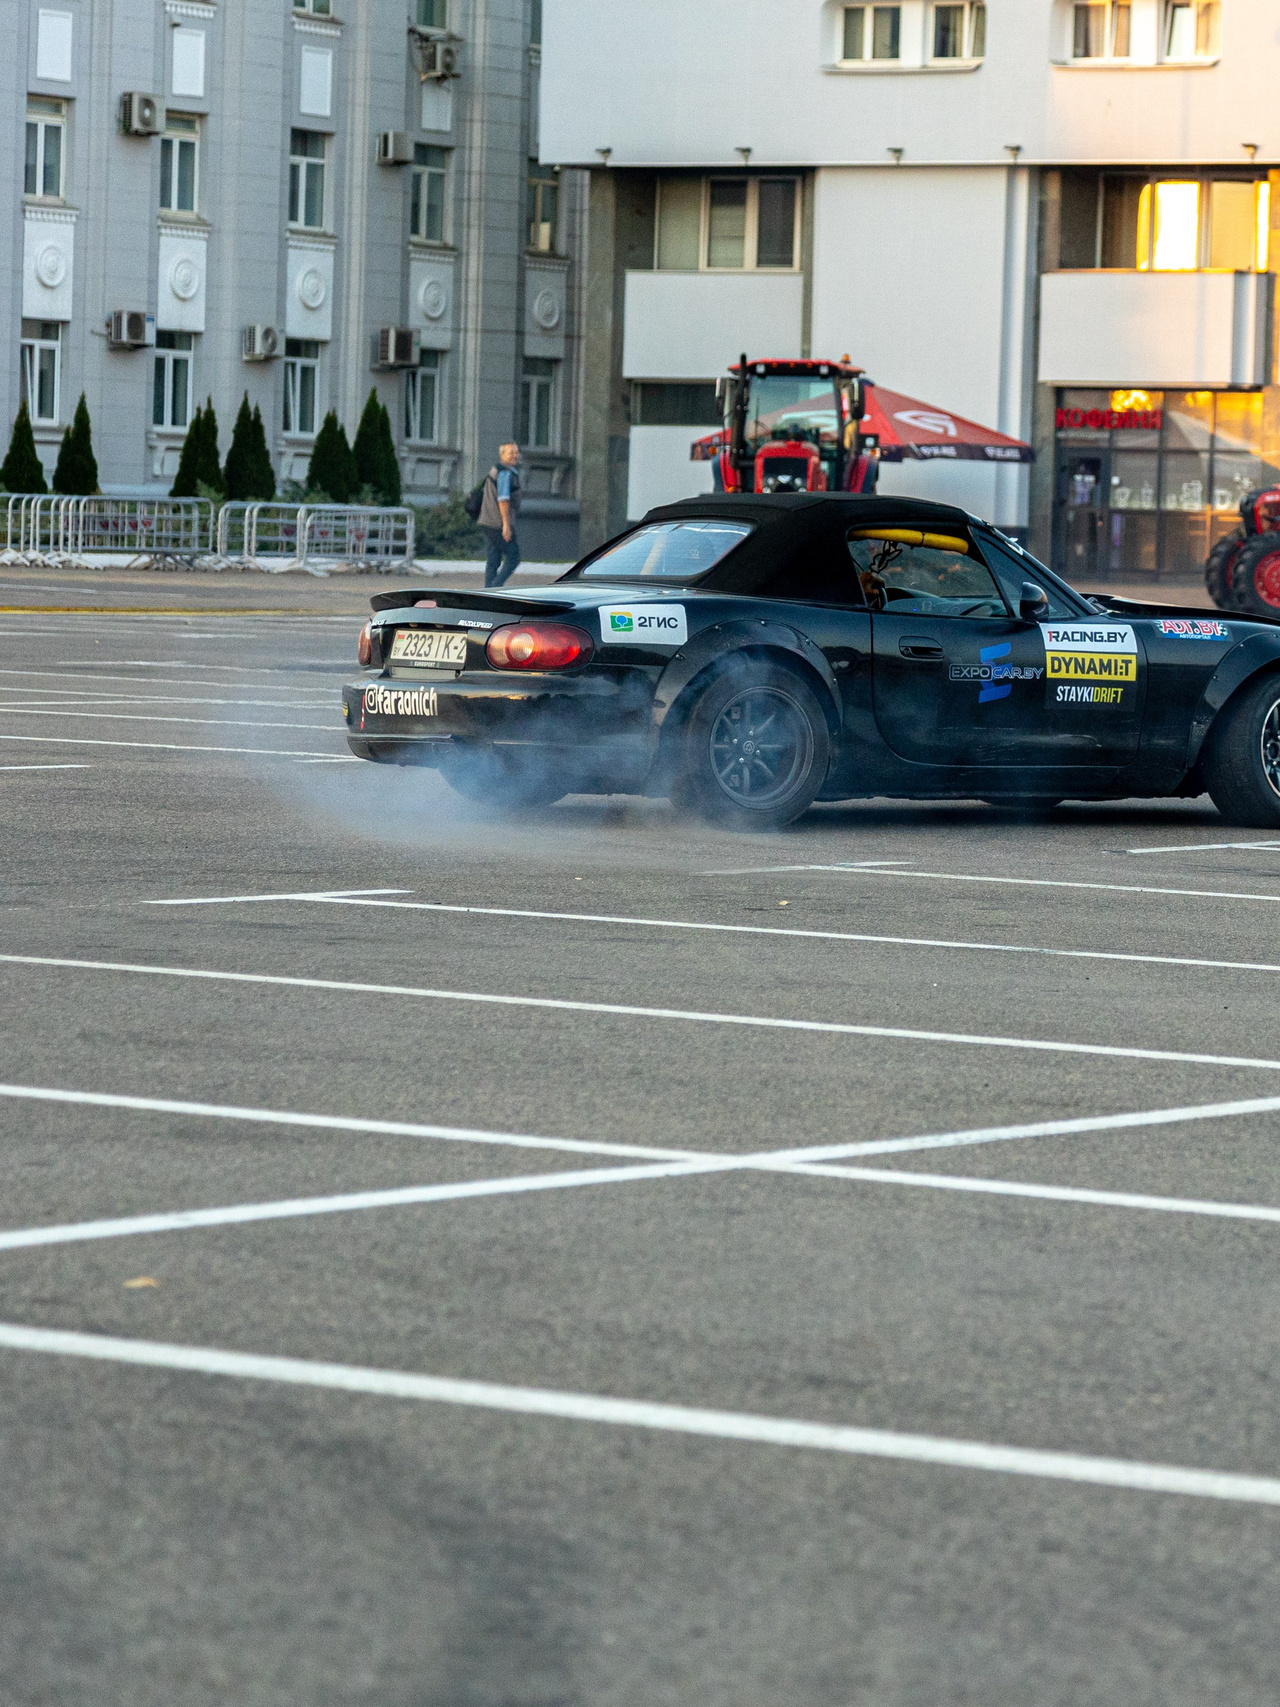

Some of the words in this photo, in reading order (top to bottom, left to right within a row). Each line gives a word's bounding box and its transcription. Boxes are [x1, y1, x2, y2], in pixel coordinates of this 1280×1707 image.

[637, 616, 678, 629] 2ГИС
[1048, 630, 1127, 643] 1RACING.BY
[402, 633, 434, 657] 2323
